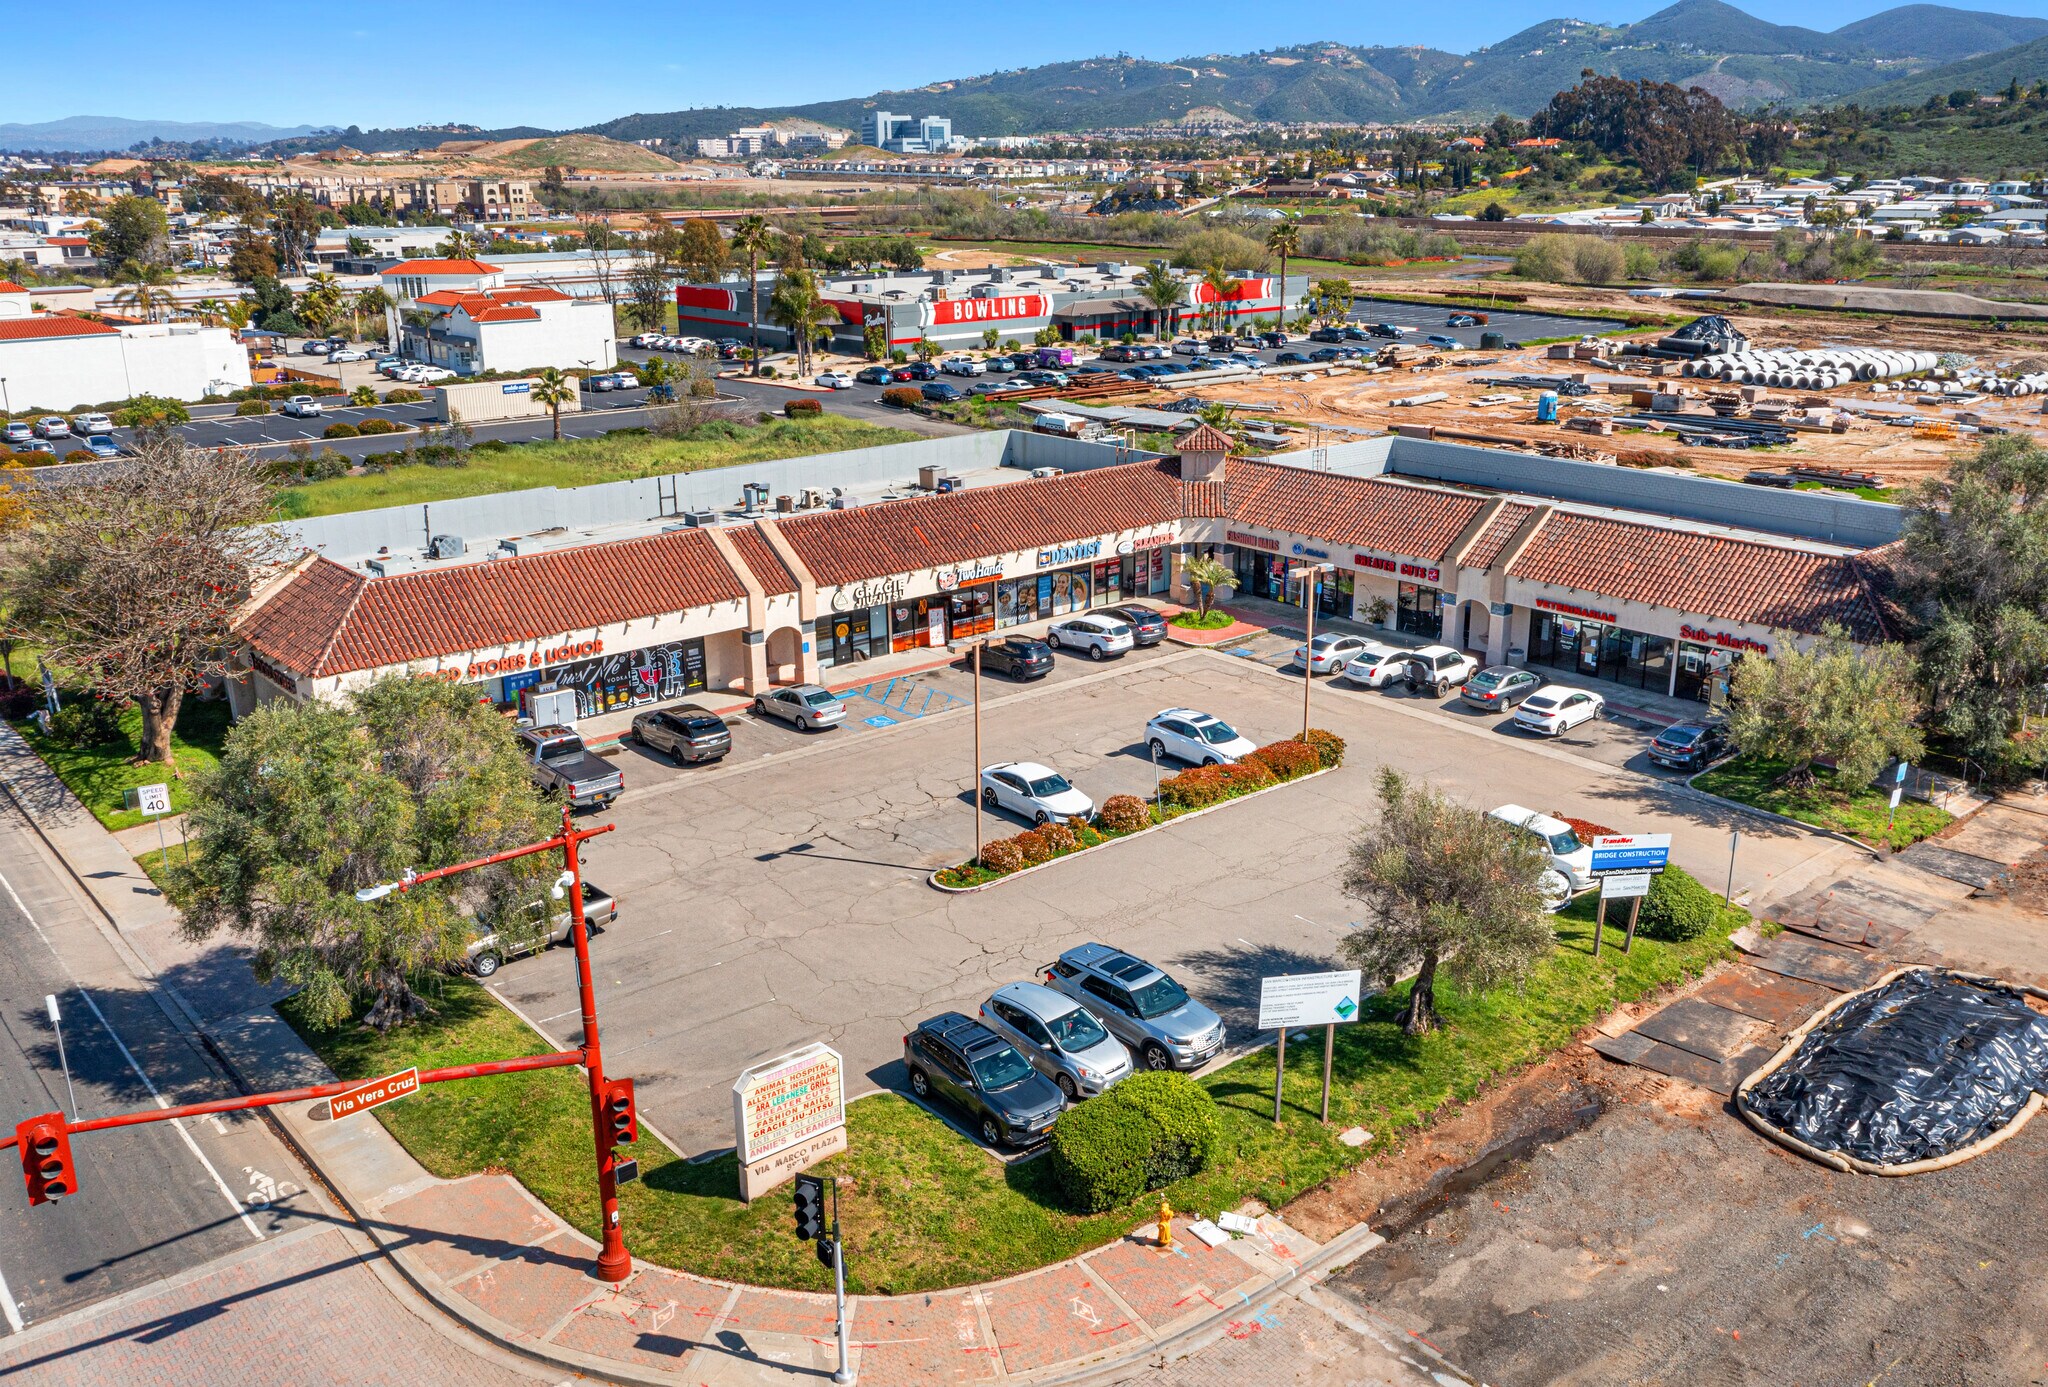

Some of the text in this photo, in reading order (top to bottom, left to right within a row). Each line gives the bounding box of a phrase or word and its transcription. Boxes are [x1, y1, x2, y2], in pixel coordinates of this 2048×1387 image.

[953, 297, 1027, 320] BOWLING
[1051, 540, 1102, 565] DENTIST
[1134, 532, 1175, 550] CLEANERS
[1226, 530, 1280, 551] FASHION NAILS
[957, 568, 976, 582] Two
[976, 561, 1005, 579] Hands
[1354, 553, 1427, 579] GREATER CUTS
[854, 578, 905, 599] GRACIE
[856, 589, 905, 606] JIU-JITSU
[1535, 598, 1616, 623] VETERINARIAN
[1679, 624, 1768, 654] Sub-Marine
[414, 639, 604, 683] OOD STORES & LIQUOR
[549, 653, 621, 686] Trust Me
[606, 675, 628, 684] VODKA
[142, 787, 163, 795] SPEED
[147, 800, 165, 811] 40
[1618, 849, 1666, 858] CONSTRUCTION
[1591, 867, 1664, 877] KeepSanDiegoMoving.com
[747, 1066, 837, 1107] ALLSTATE INSURANCE
[754, 1062, 830, 1096] ANIMAL HOSPITAL
[333, 1077, 415, 1113] Via Vera Cruz
[755, 1101, 770, 1113] ARA
[810, 1078, 830, 1091] GRILL
[755, 1085, 831, 1120] GREATER CUTS
[753, 1101, 834, 1138] GRACIE JIU-JITSU
[756, 1094, 830, 1128] FASHION NAILS
[773, 1122, 805, 1138] DENTAL
[807, 1106, 840, 1124] CENTER
[749, 1114, 841, 1158] ANNIE'S CLEANERS
[754, 1135, 838, 1176] VIA MARCO PLAZA
